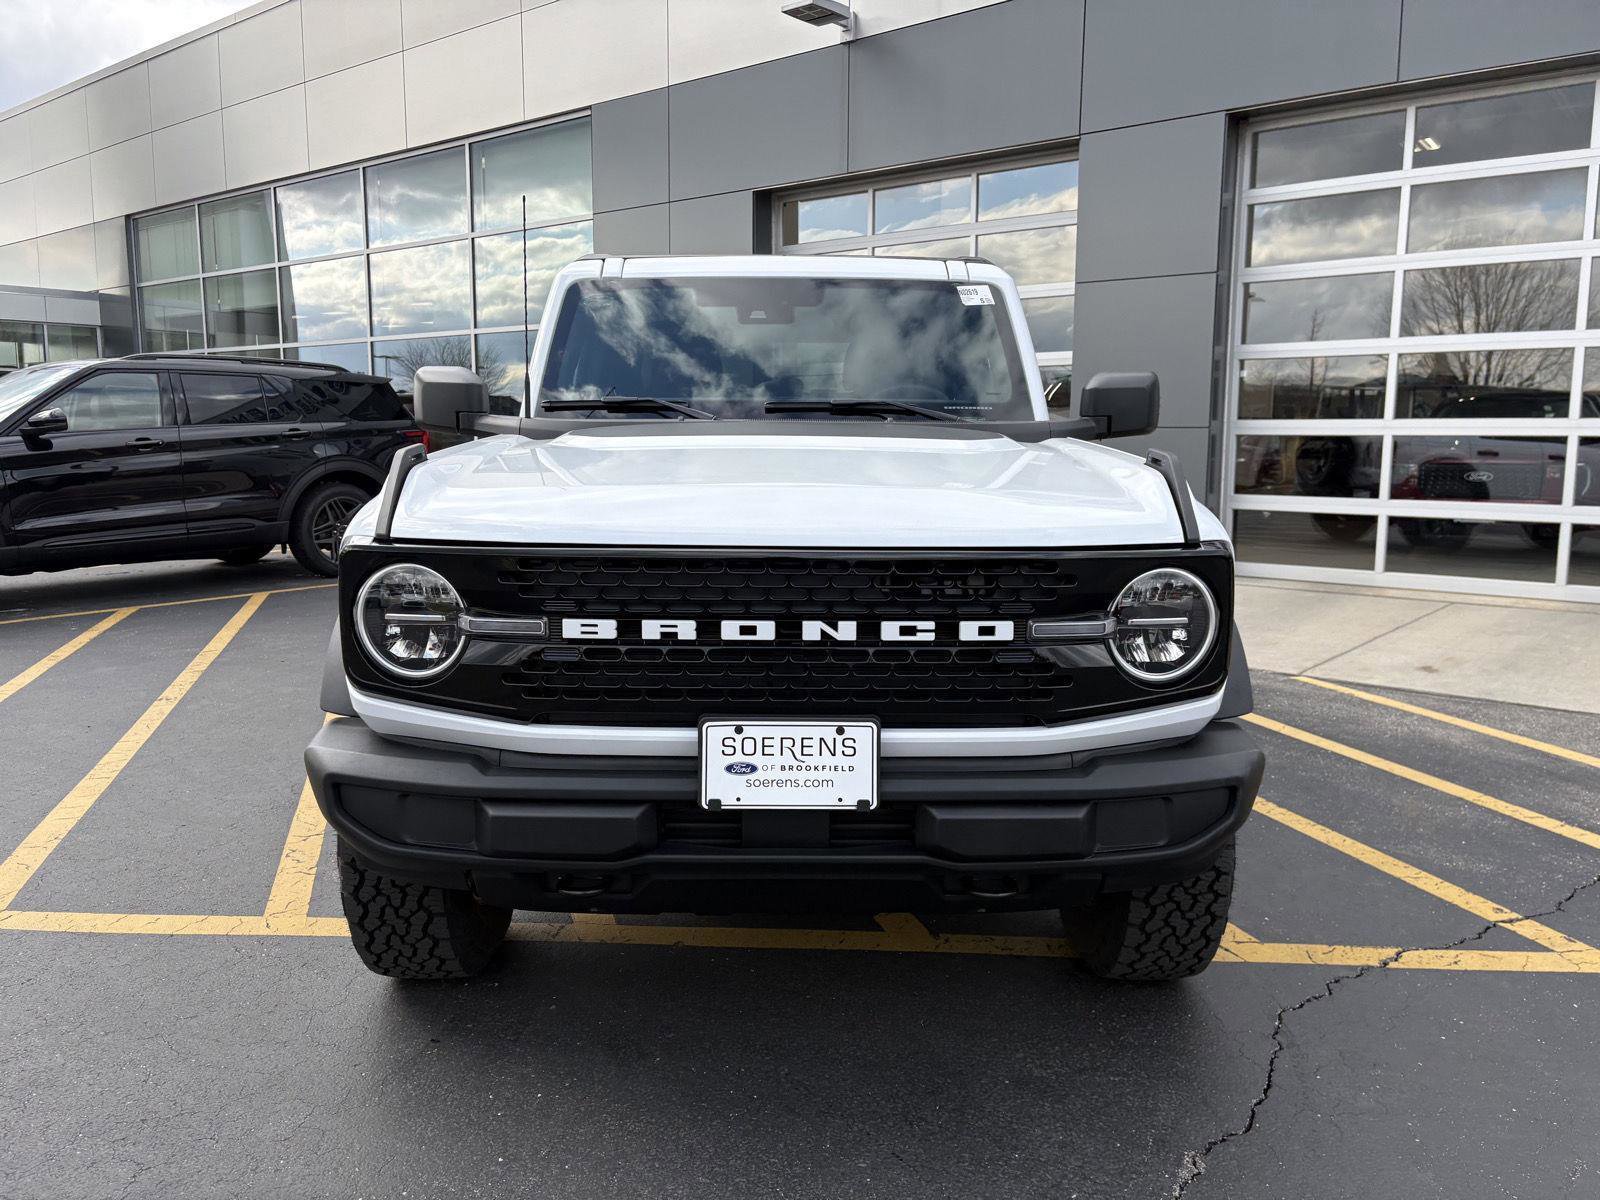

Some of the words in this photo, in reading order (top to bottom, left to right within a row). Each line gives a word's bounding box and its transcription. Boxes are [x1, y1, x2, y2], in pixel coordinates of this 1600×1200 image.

[561, 618, 1014, 642] BRONCO
[721, 736, 857, 763] SOERENS
[762, 764, 776, 772] OF
[780, 764, 856, 772] BROOKFIELD
[745, 778, 834, 788] soerens.com
